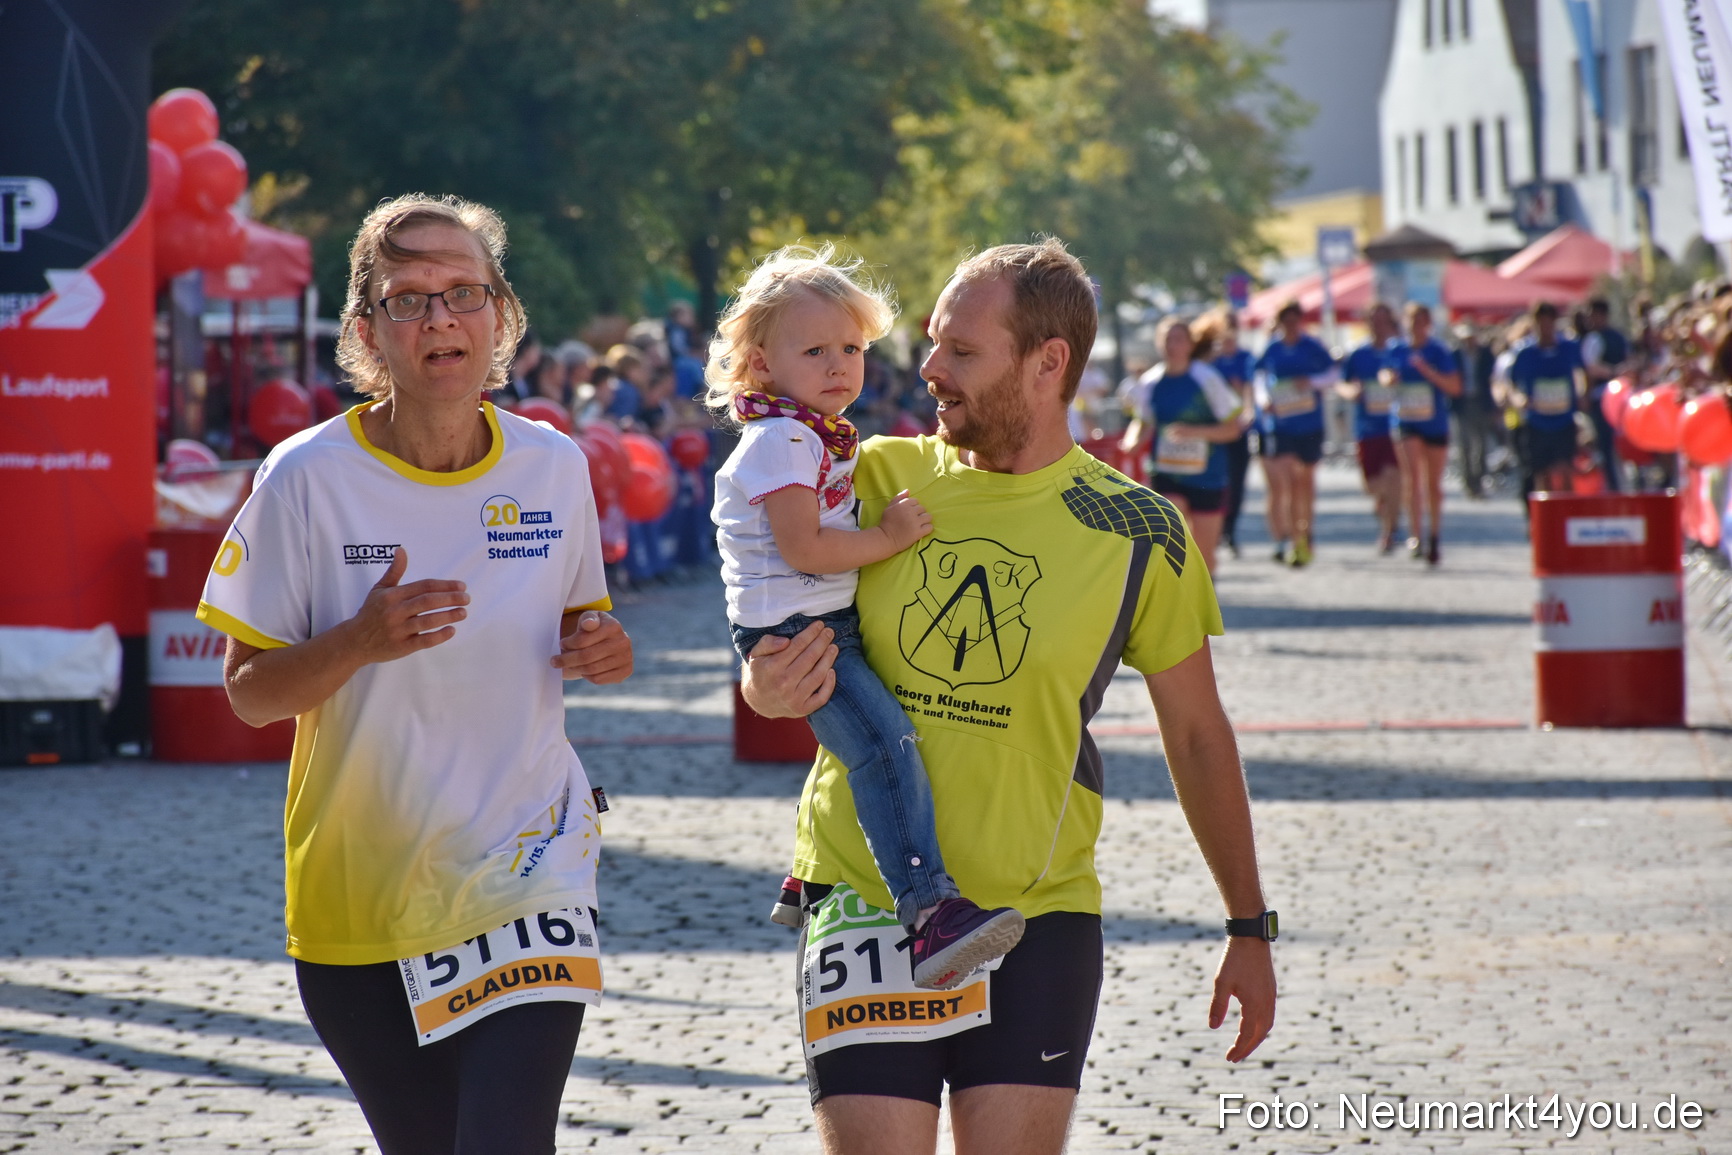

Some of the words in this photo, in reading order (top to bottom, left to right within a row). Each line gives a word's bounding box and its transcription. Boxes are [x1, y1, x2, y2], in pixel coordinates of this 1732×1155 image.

[2, 373, 109, 401] Laufsport
[485, 503, 519, 527] 20
[522, 513, 549, 524] JAHRE
[487, 528, 564, 542] Neumarkter
[488, 544, 550, 559] Stadtlauf
[993, 560, 1029, 590] K
[895, 684, 933, 705] Georg
[937, 693, 1012, 717] Klughardt
[899, 702, 920, 713] uck-
[923, 709, 944, 719] und
[947, 711, 1009, 729] Trockenbau
[813, 888, 896, 938] BO
[424, 907, 576, 988] 5116
[820, 936, 918, 994] 511
[447, 963, 573, 1014] CLAUDIA
[826, 996, 964, 1030] NORBERT
